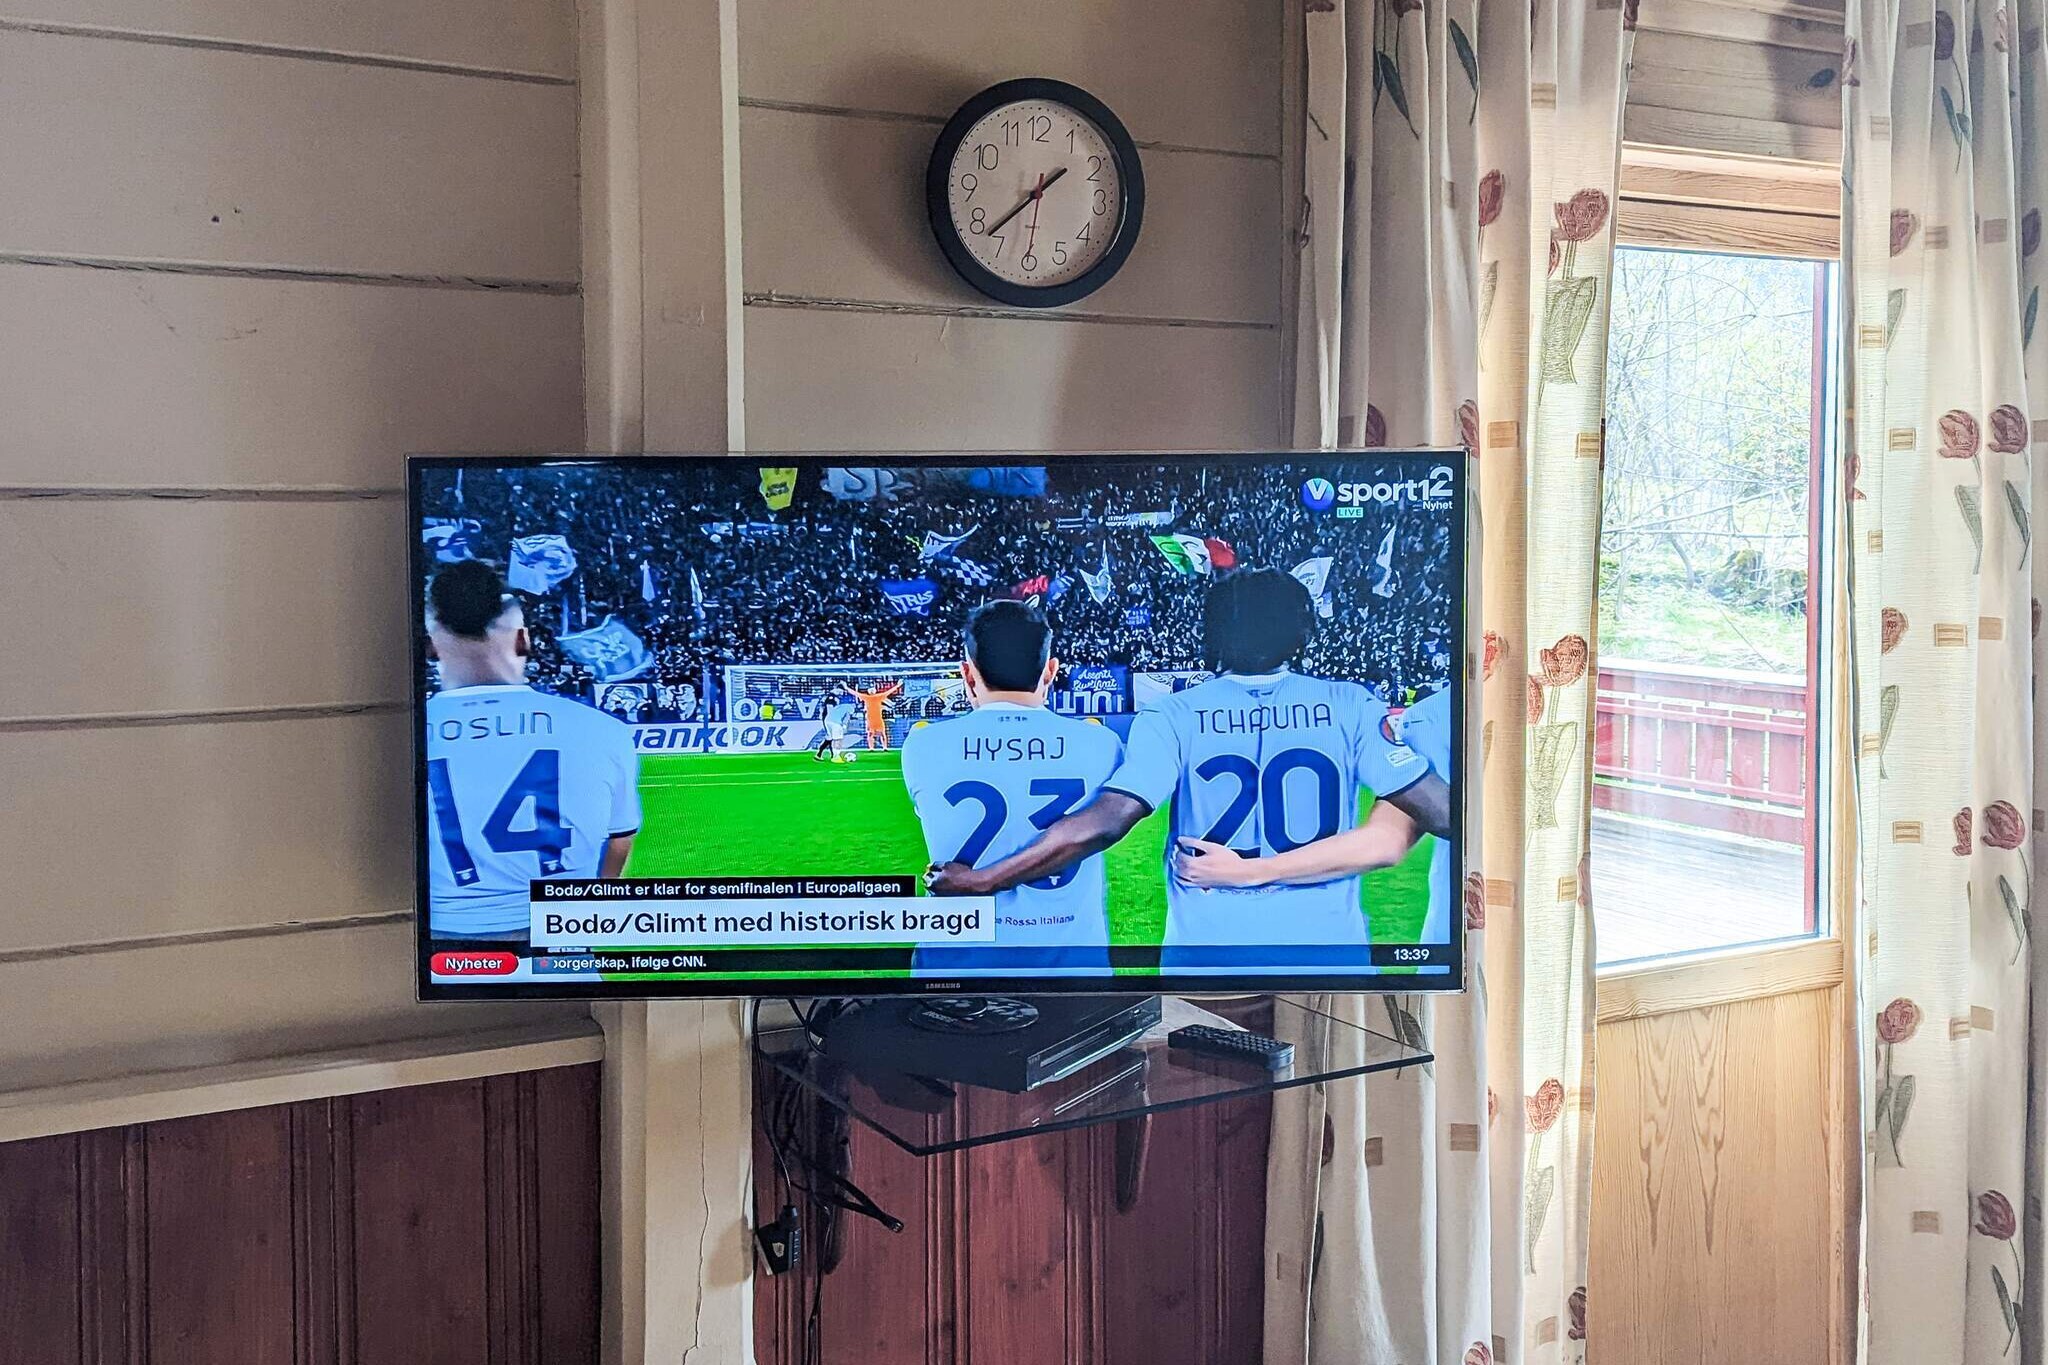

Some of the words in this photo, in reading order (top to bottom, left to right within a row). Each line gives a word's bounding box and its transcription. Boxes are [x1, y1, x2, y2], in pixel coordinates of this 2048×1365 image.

[1001, 120, 1019, 147] 11
[1027, 115, 1051, 142] 12
[1066, 129, 1074, 154] 1
[973, 143, 999, 170] 10
[1086, 155, 1101, 181] 2
[961, 173, 977, 202] 9
[1092, 189, 1106, 216] 3
[969, 207, 985, 235] 8
[1076, 221, 1091, 247] 4
[992, 235, 1005, 258] 7
[1021, 243, 1037, 271] 6
[1052, 241, 1066, 266] 5
[1305, 480, 1329, 500] V
[1338, 508, 1361, 516] LIVE
[1423, 501, 1453, 510] Nyhet
[964, 737, 1065, 761] HYSAJ
[1195, 748, 1341, 860] 20
[428, 749, 572, 887] 14
[943, 778, 1086, 890] 23
[544, 883, 631, 897] Bodø/Glimt
[634, 886, 650, 896] er
[654, 883, 680, 896] klar
[685, 883, 706, 895] for
[709, 882, 793, 895] semifinalen
[806, 881, 900, 897] Europaligaen
[545, 912, 707, 934] Bodø/Glimt
[715, 911, 772, 932] med
[780, 910, 896, 932] historisk
[902, 909, 980, 935] bragd
[444, 957, 503, 972] Nyheter
[631, 955, 669, 970] ifølge
[672, 955, 707, 968] CNN.
[1394, 948, 1430, 960] 13:39
